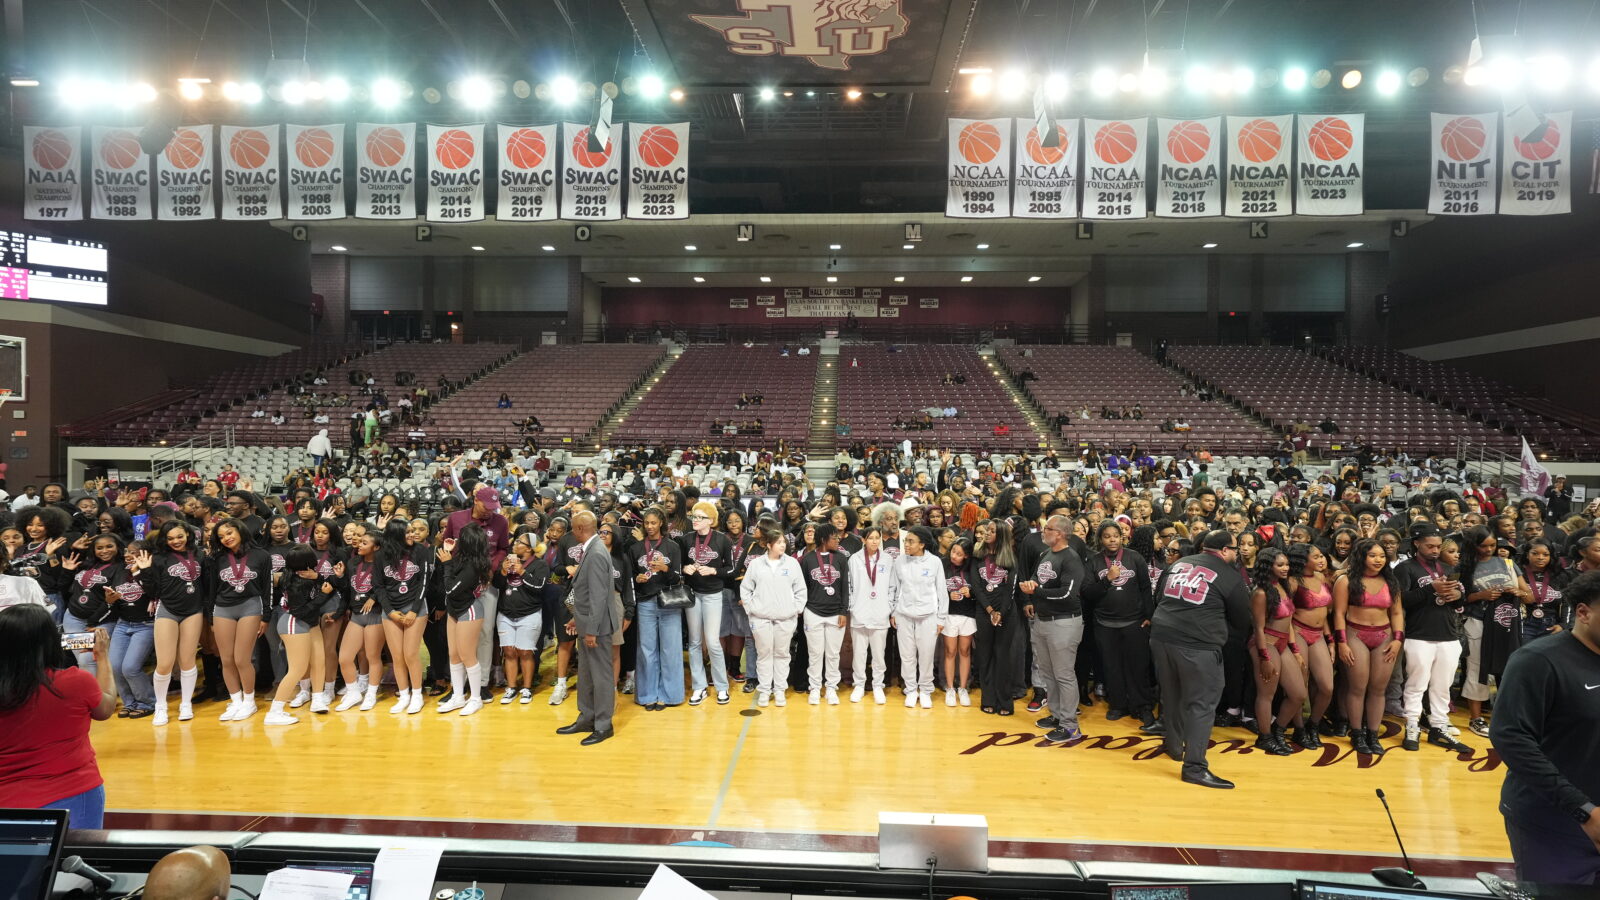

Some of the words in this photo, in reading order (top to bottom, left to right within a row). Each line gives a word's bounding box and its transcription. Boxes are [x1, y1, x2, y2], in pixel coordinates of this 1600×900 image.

[953, 165, 1005, 178] NCAA
[1020, 165, 1072, 178] NCAA
[1091, 168, 1140, 180] NCAA
[1161, 164, 1217, 180] NCAA
[1230, 164, 1288, 180] NCAA
[1301, 163, 1360, 178] NCAA
[1438, 159, 1491, 179] NIT
[1512, 159, 1561, 180] CIT
[28, 169, 77, 184] NAIA
[95, 170, 147, 186] SWAC
[160, 170, 211, 186] SWAC
[225, 169, 276, 185] SWAC
[291, 169, 341, 185] SWAC
[360, 167, 412, 184] SWAC
[431, 169, 480, 186] SWAC
[501, 169, 553, 186] SWAC
[565, 168, 618, 185] SWAC
[632, 168, 685, 184] SWAC
[950, 179, 1008, 187] TOURNAMENT
[1017, 179, 1076, 187] TOURNAMENT
[1086, 181, 1144, 189] TOURNAMENT
[1165, 180, 1214, 188] TOURNAMENT
[237, 194, 268, 204] 1994
[302, 194, 331, 203] 1998
[371, 194, 400, 203] 2011
[643, 194, 675, 203] 2022
[963, 192, 994, 201] 1990
[1030, 191, 1061, 201] 1995
[1098, 192, 1132, 202] 2014
[1172, 191, 1205, 201] 2017
[1242, 191, 1276, 200] 2021
[1311, 189, 1346, 199] 2023
[1444, 190, 1478, 200] 2011
[1517, 190, 1555, 200] 2019
[106, 195, 136, 204] 1983
[172, 195, 201, 204] 1990
[441, 196, 471, 206] 2014
[512, 196, 542, 206] 2016
[576, 195, 606, 205] 2018
[106, 207, 136, 216] 1988
[172, 207, 201, 216] 1992
[237, 206, 267, 215] 1995
[302, 206, 331, 215] 2003
[371, 206, 401, 215] 2013
[575, 206, 606, 216] 2021
[643, 205, 675, 215] 2023
[963, 203, 994, 213] 1994
[1029, 203, 1061, 213] 2003
[1098, 206, 1131, 215] 2015
[1172, 203, 1205, 213] 2018
[1242, 203, 1277, 213] 2022
[1443, 202, 1478, 212] 2016
[39, 208, 68, 217] 1977
[441, 208, 471, 218] 2015
[512, 208, 542, 217] 2017
[418, 227, 430, 240] P
[577, 227, 589, 240] O
[739, 226, 752, 239] N
[906, 225, 921, 238] M
[1079, 224, 1090, 238] L
[1252, 223, 1266, 237] K
[1394, 223, 1406, 237] J
[1170, 573, 1200, 589] Fall
